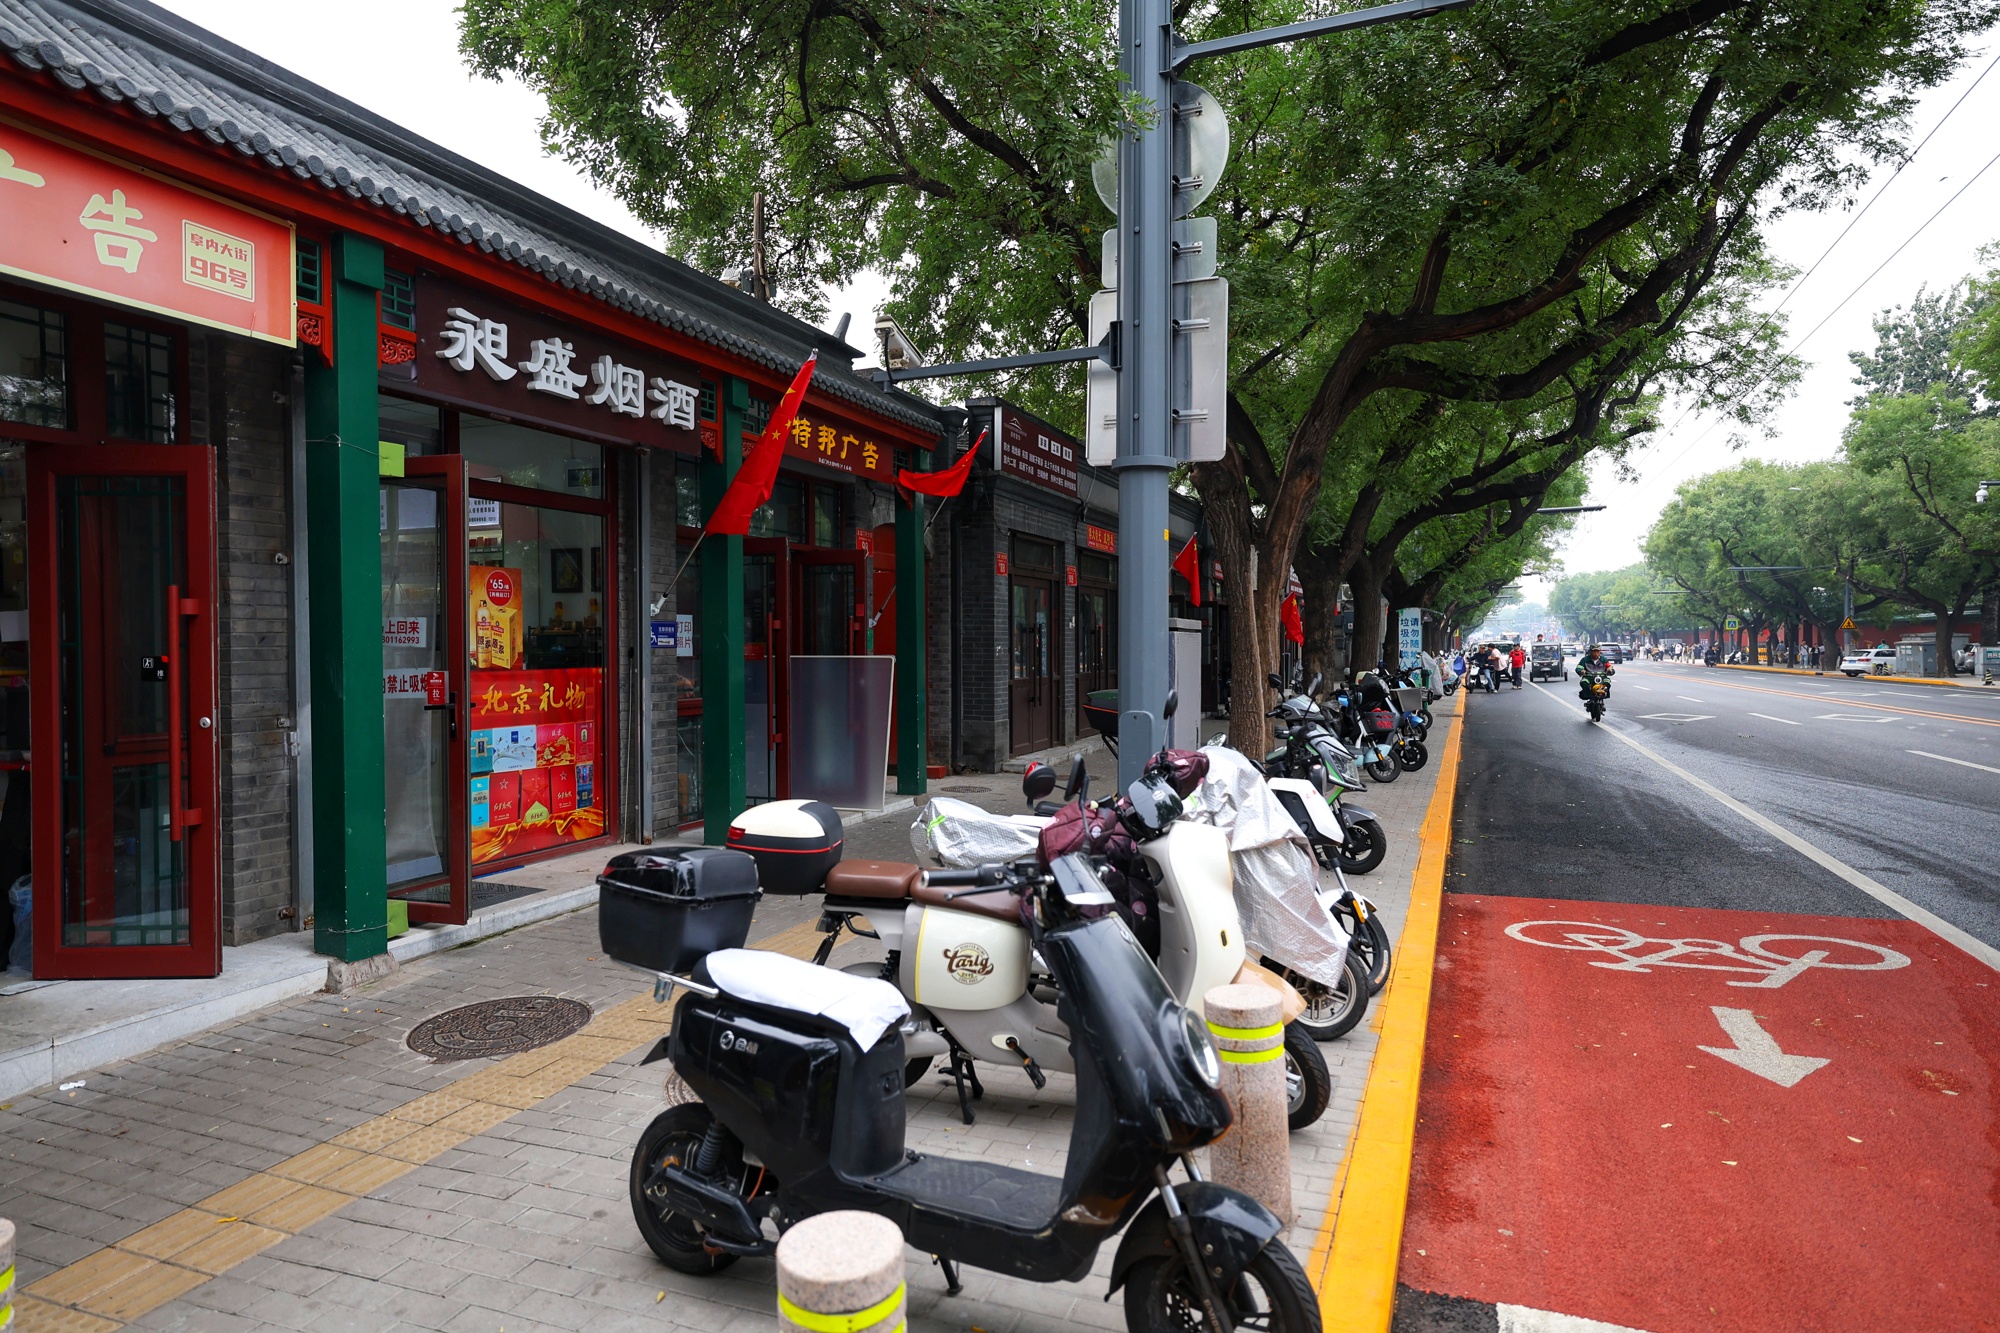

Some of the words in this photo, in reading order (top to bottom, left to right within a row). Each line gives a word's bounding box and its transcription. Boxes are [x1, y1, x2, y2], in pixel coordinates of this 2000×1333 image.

[190, 233, 248, 262] 阜内大街
[190, 256, 248, 289] 96号
[435, 307, 699, 431] 昶盛烟酒
[791, 415, 879, 470] 特邦广告
[382, 620, 420, 635] 上回来
[383, 673, 428, 694] 禁止吸烟
[480, 681, 586, 715] 北京礼物
